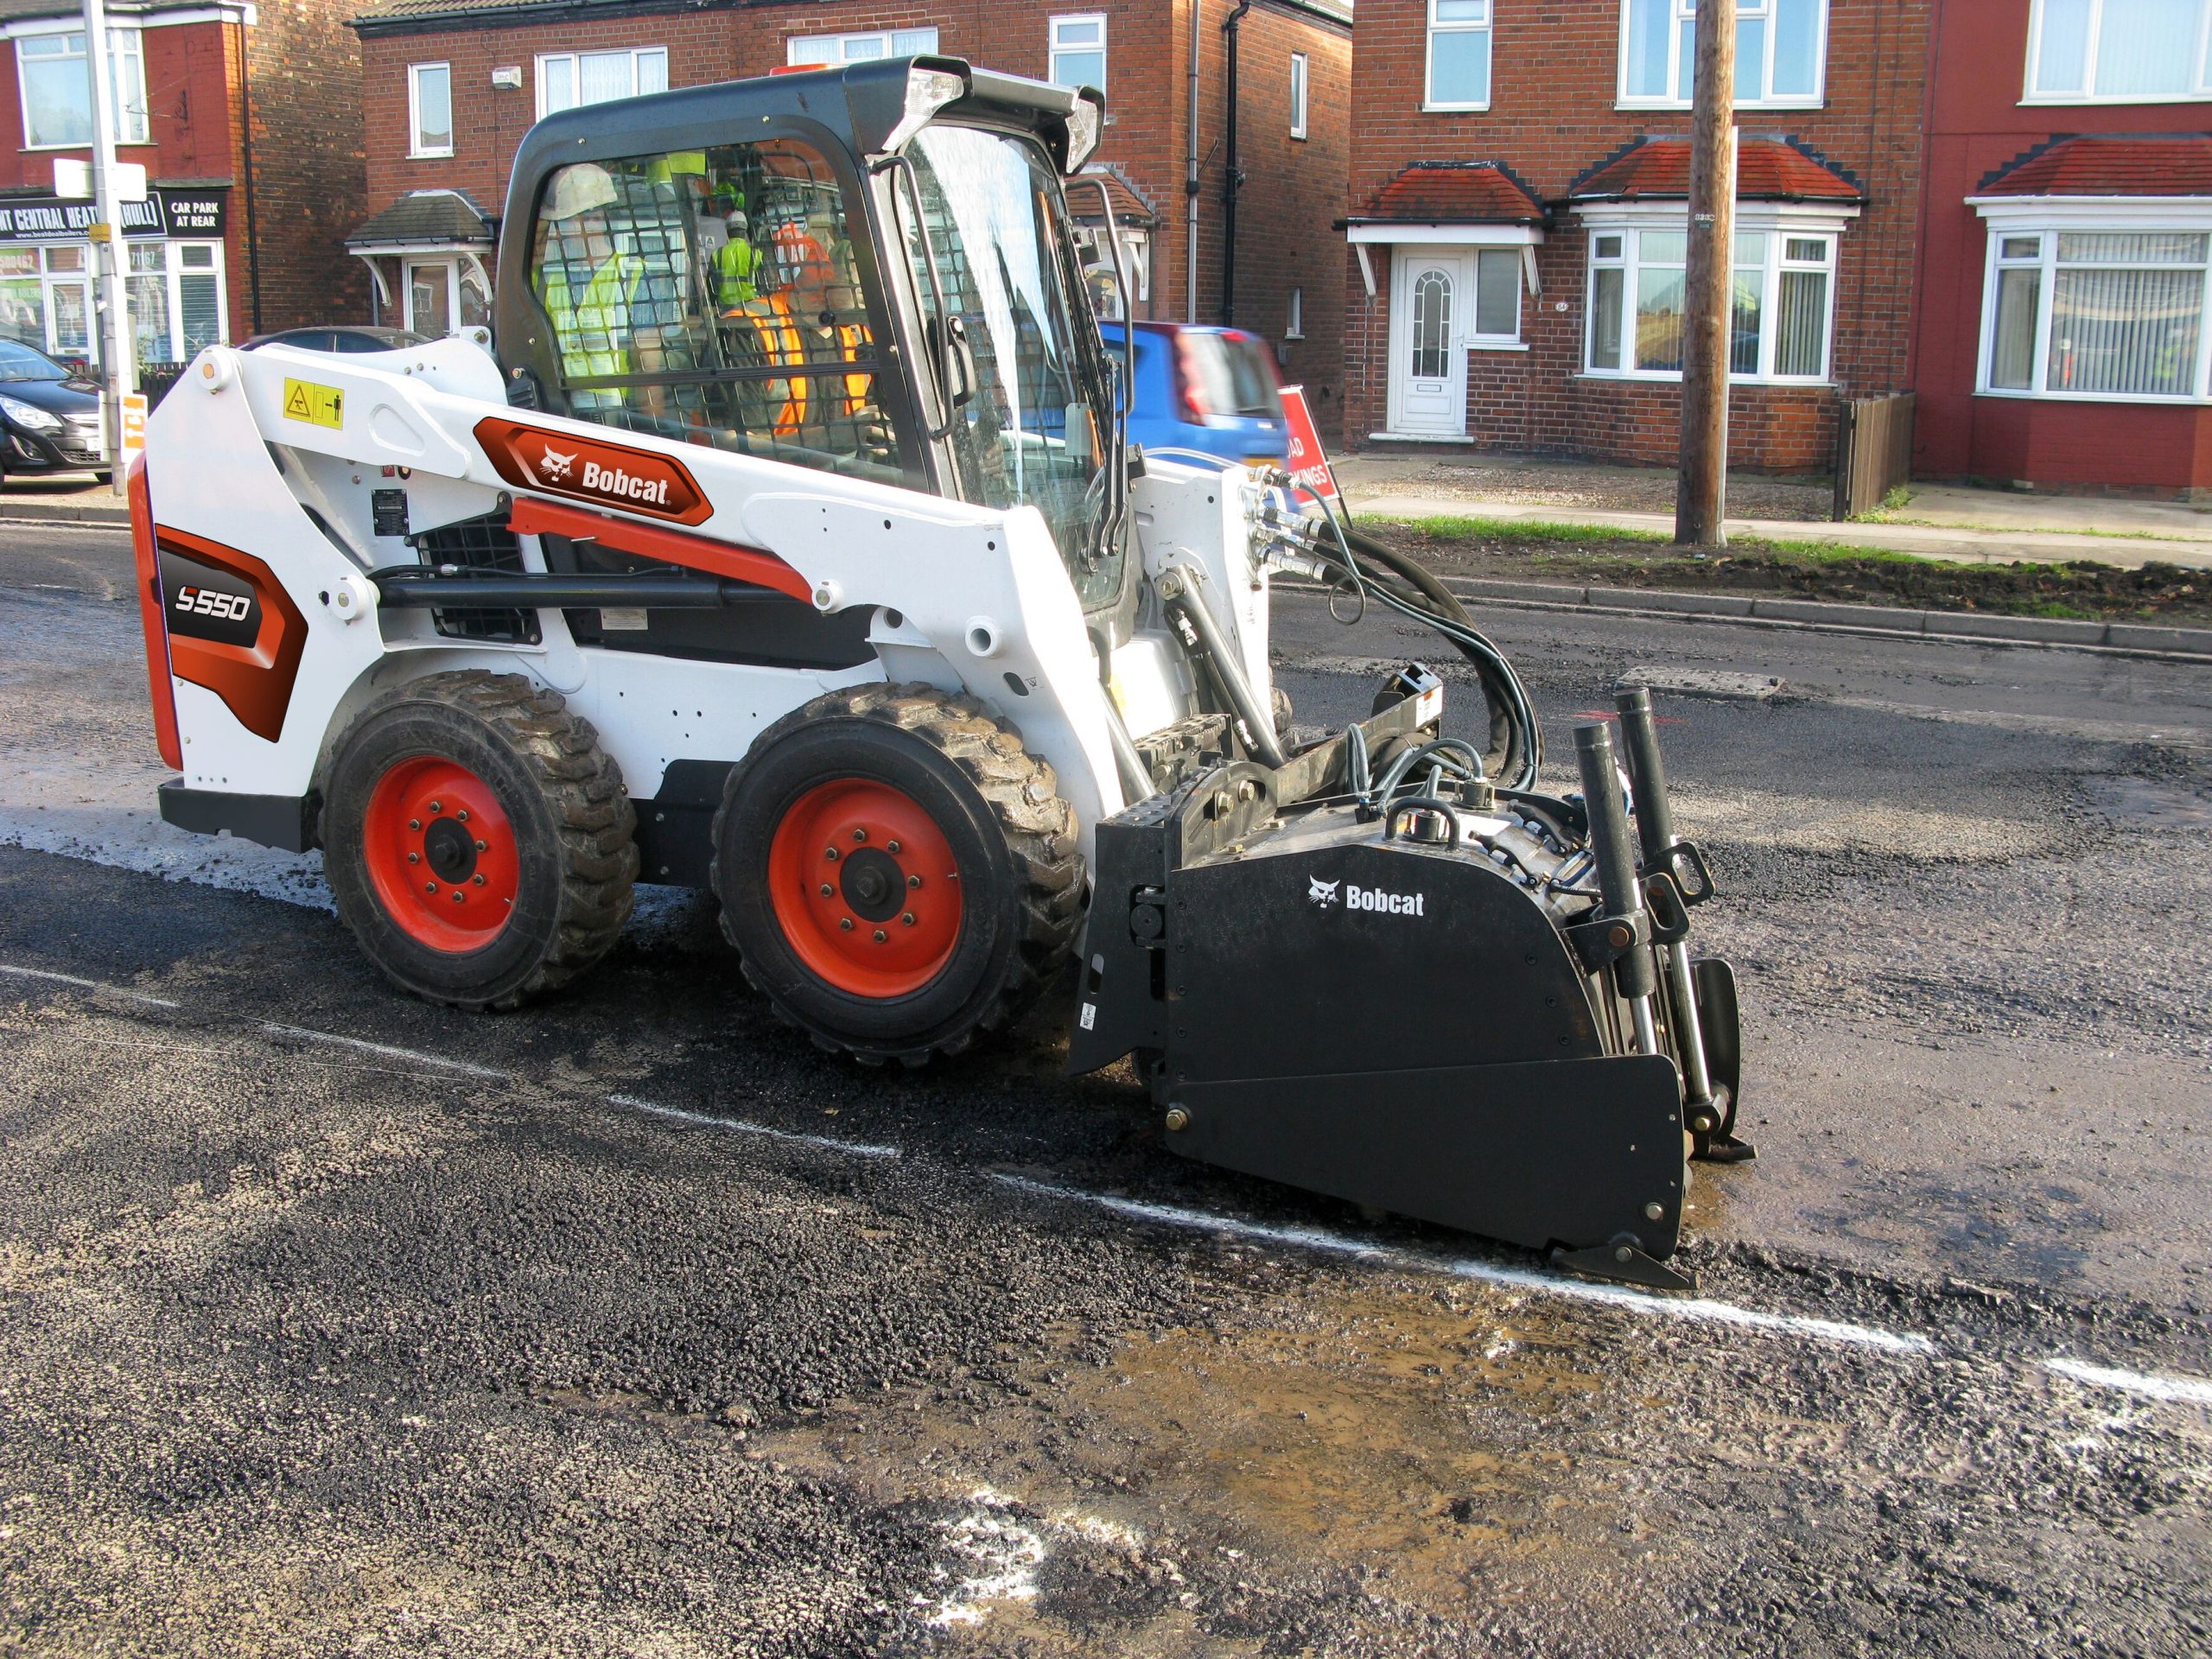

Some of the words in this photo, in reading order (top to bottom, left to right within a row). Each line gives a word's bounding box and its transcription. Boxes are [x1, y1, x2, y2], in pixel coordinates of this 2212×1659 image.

[15, 207, 67, 231] CENTRAL
[65, 205, 97, 229] HEAT
[120, 200, 158, 228] (HULL)
[171, 201, 191, 214] CAR
[193, 201, 219, 214] PARK
[176, 215, 189, 227] AT
[191, 215, 216, 227] REAR
[129, 251, 156, 266] 71167
[1287, 437, 1304, 458] AD
[582, 461, 668, 504] Bobcat
[175, 586, 251, 621] S550
[1345, 885, 1424, 916] Bobcat
